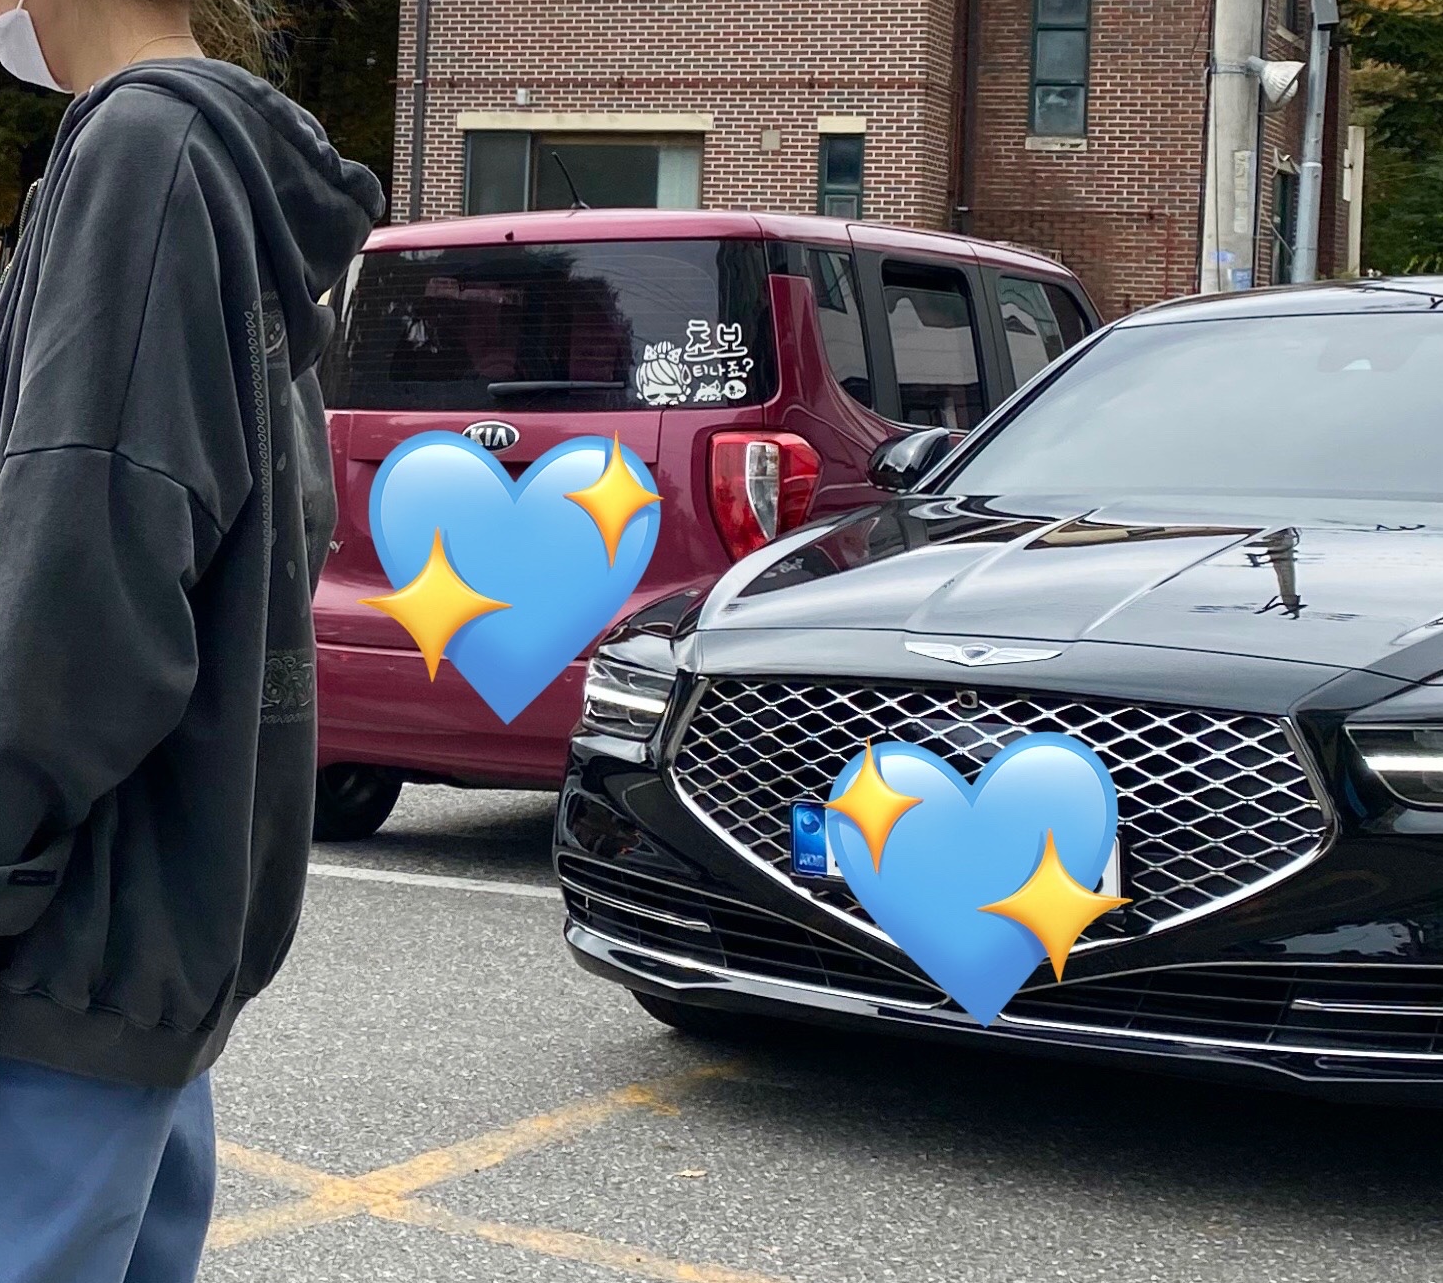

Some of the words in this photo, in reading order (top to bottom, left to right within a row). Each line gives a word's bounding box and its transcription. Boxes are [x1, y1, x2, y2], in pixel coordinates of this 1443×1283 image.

[683, 319, 748, 362] 초보
[692, 358, 754, 378] 티나죠?
[470, 427, 508, 446] KIA
